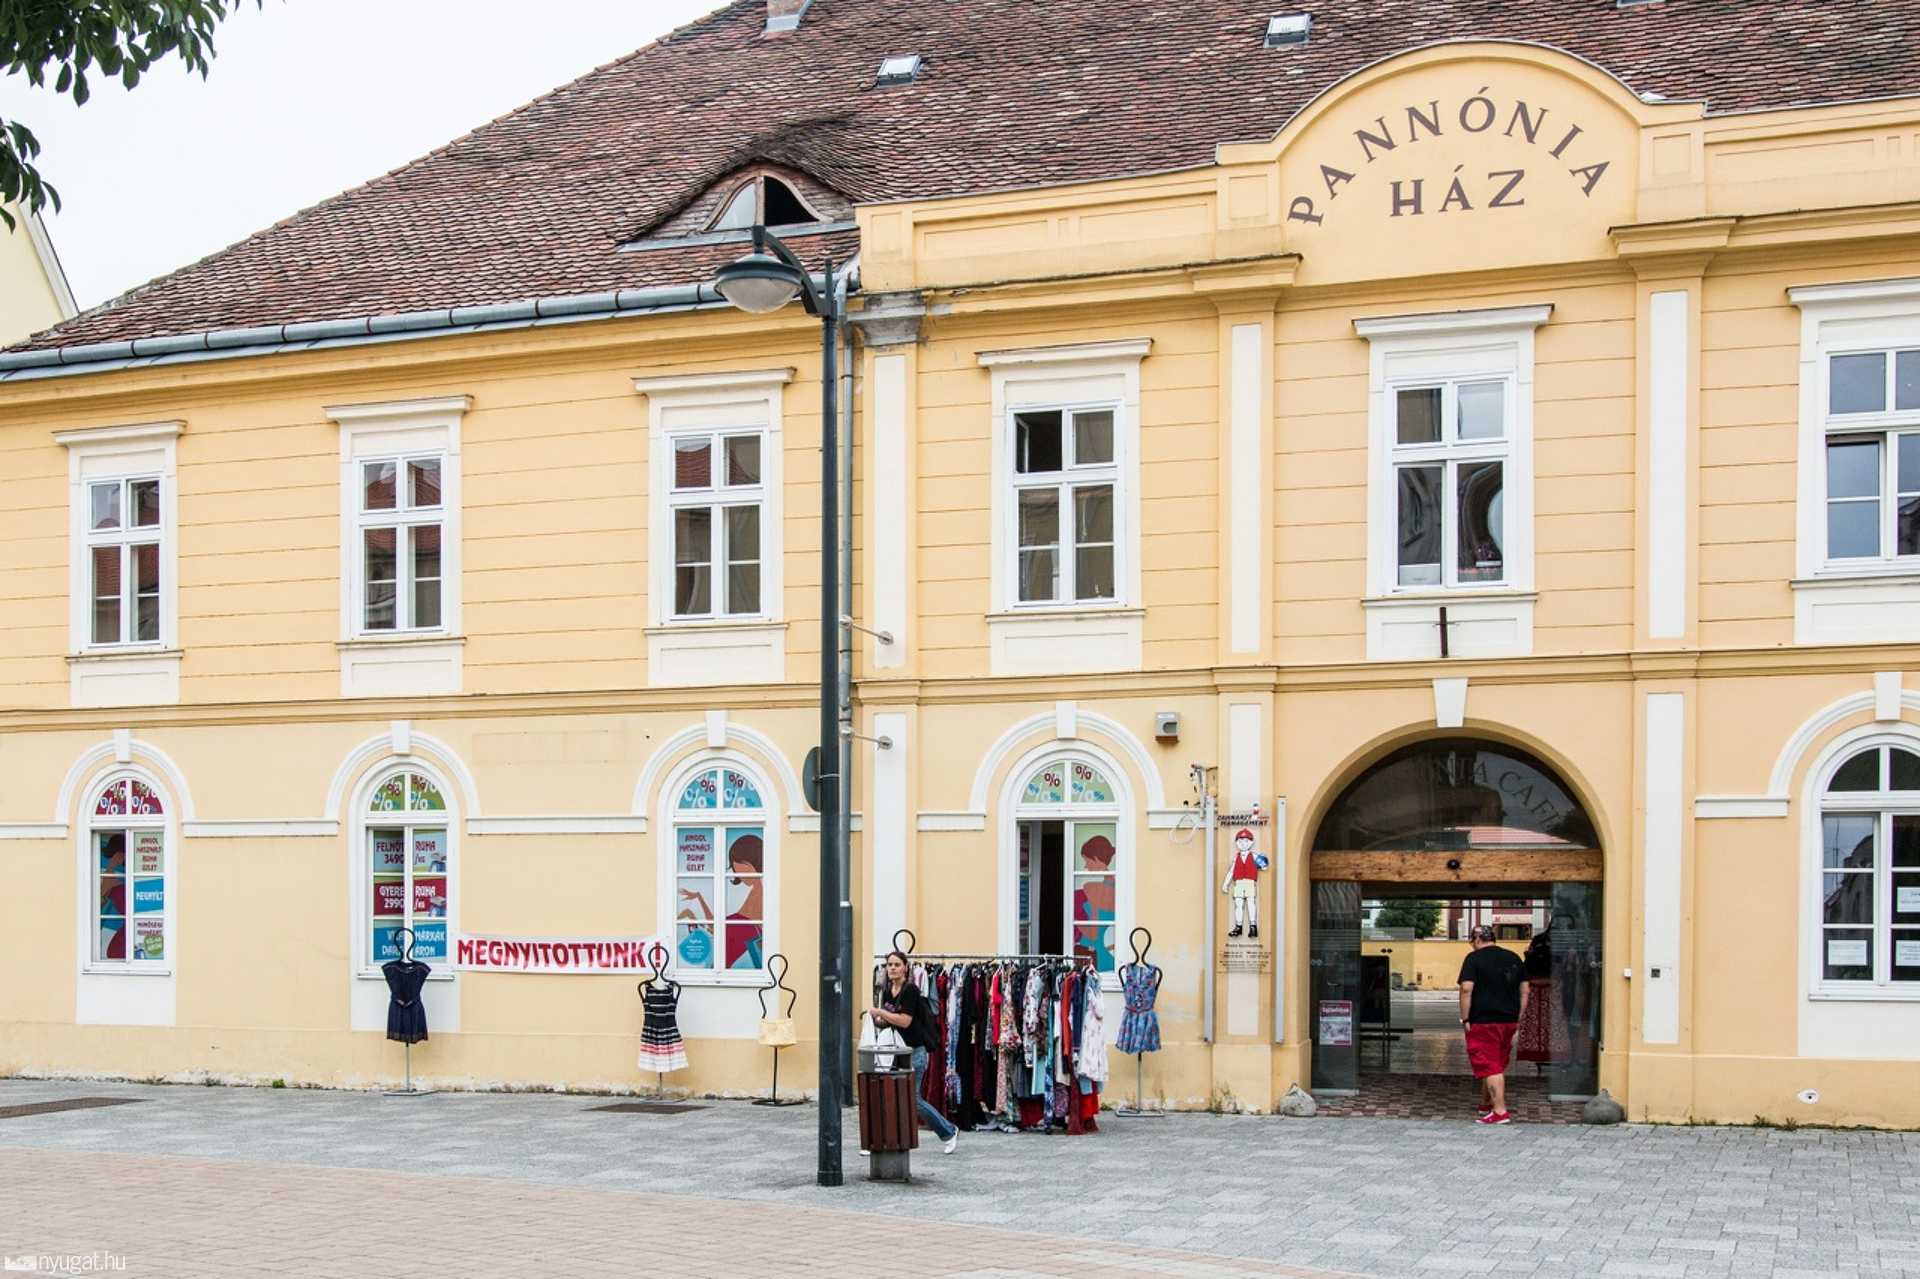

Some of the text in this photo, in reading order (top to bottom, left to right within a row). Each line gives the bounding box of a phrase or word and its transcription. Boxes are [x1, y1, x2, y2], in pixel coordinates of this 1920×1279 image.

[1287, 86, 1611, 226] PANNÓNIA
[1389, 163, 1525, 217] HÁZ
[415, 840, 436, 852] RUHA
[415, 885, 436, 897] RUHA
[457, 939, 646, 969] MEGNYITOTTUNK
